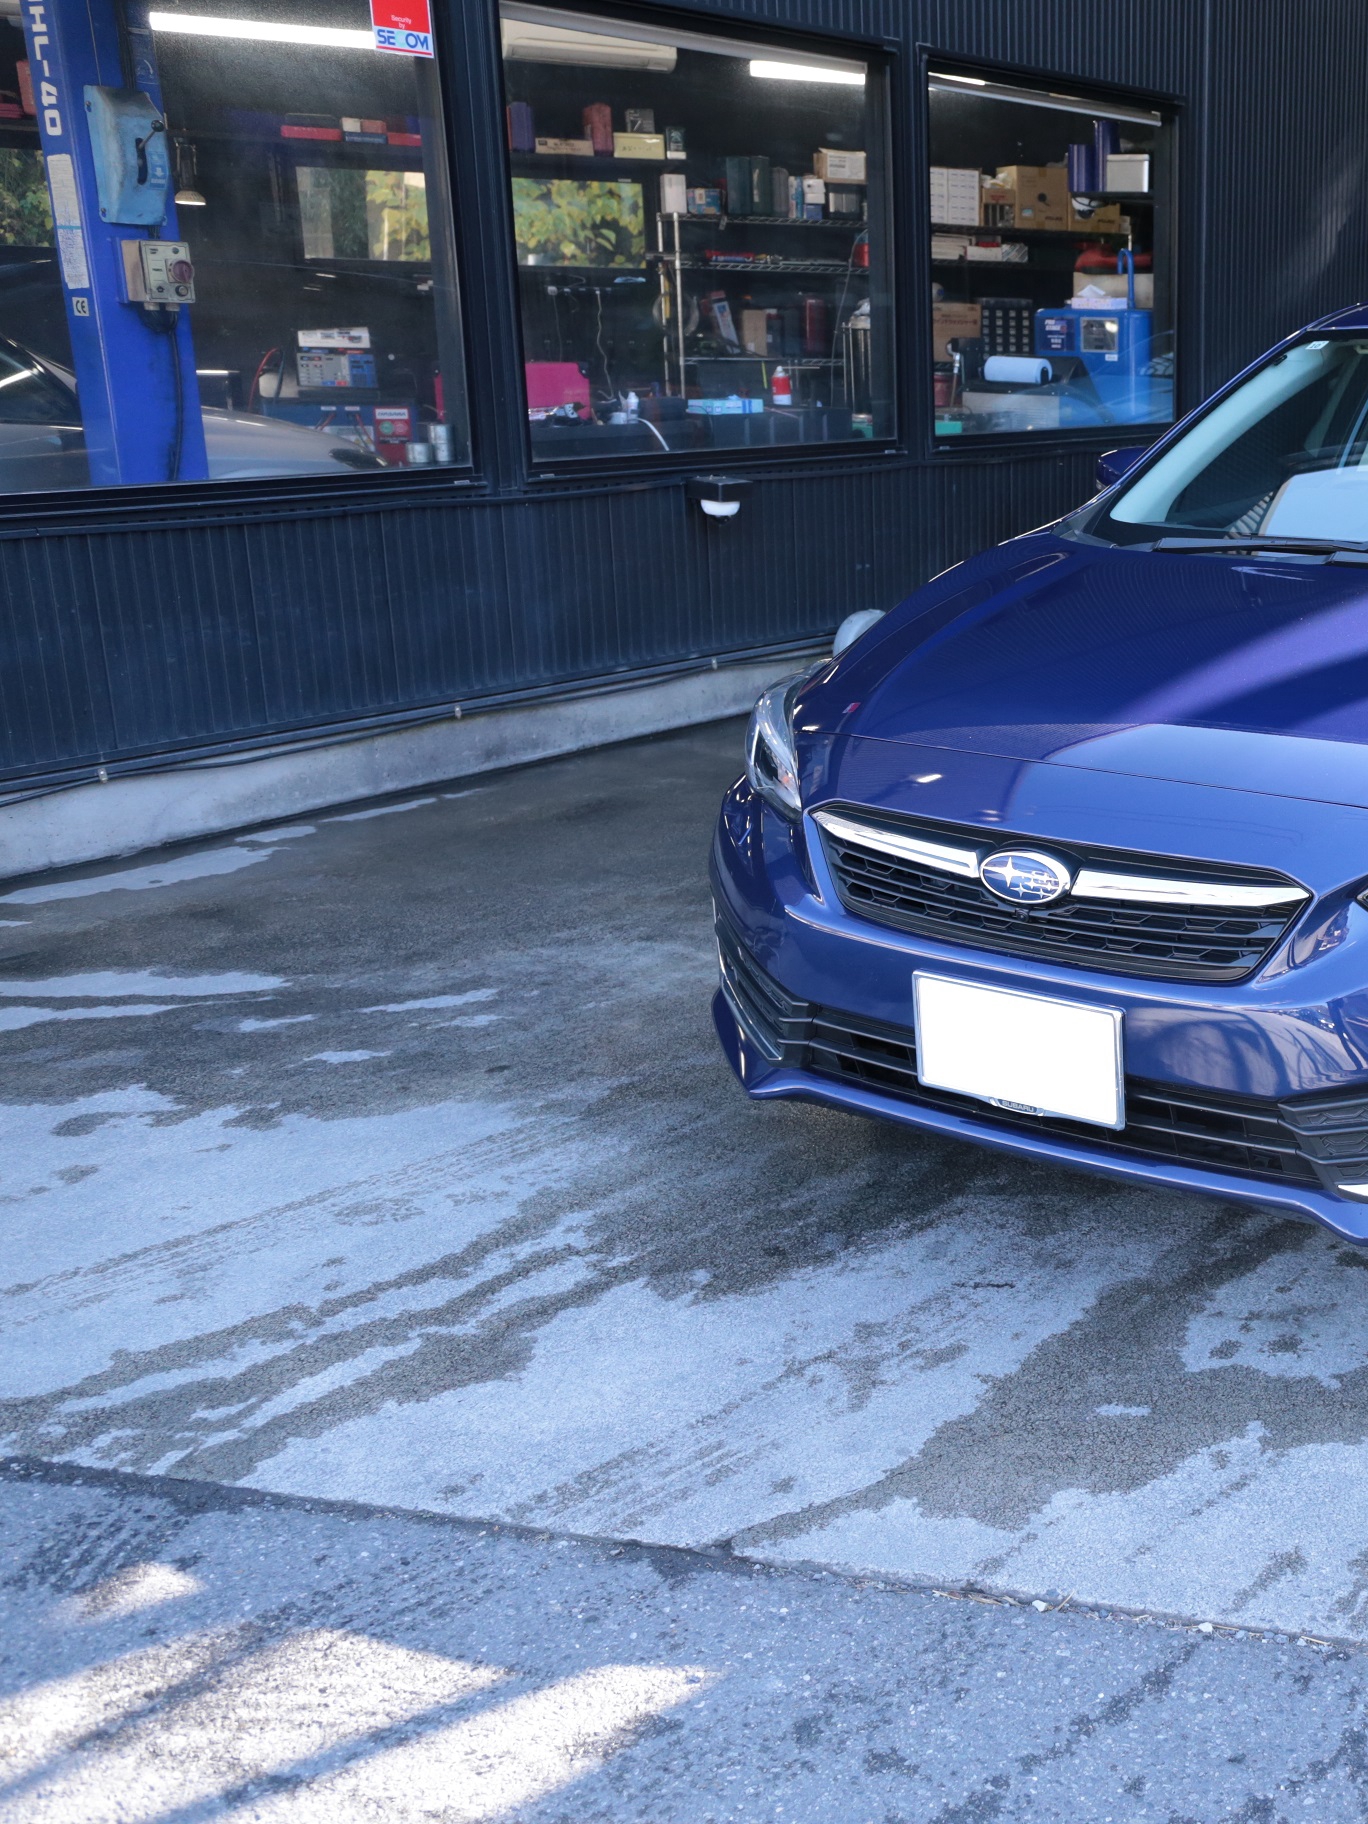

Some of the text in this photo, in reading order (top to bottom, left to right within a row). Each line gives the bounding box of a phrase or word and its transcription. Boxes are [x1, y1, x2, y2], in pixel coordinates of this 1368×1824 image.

[391, 15, 411, 24] Security
[377, 29, 429, 50] SECOM
[28, 0, 62, 136] HL-40
[1002, 1100, 1034, 1113] SUBARU
